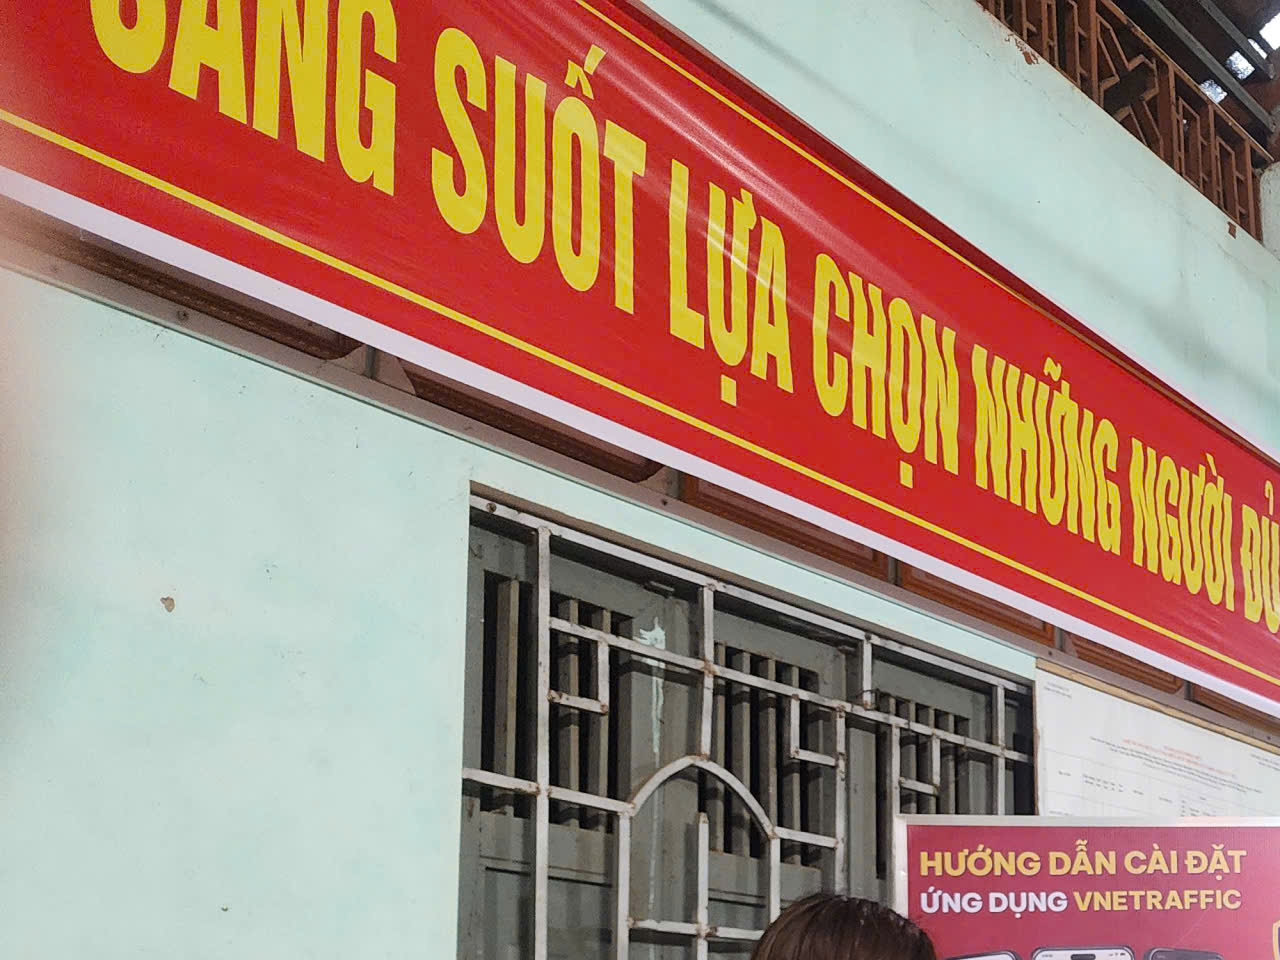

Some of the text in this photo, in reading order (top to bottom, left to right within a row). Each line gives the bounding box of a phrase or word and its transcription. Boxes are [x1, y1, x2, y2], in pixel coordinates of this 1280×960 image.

[90, 0, 397, 196] NG
[431, 27, 646, 315] SUỐT
[667, 165, 794, 406] LỰA
[813, 253, 959, 489] CHỌN
[972, 344, 1121, 555] NHỮNG
[1129, 437, 1234, 611] NGƯỜI
[1240, 480, 1280, 634] ĐỦ
[920, 840, 1246, 880] HƯỚNG DẪN CÀI ĐẶT
[920, 887, 1242, 918] ỨNG DỤNG VNETRAFFIC
